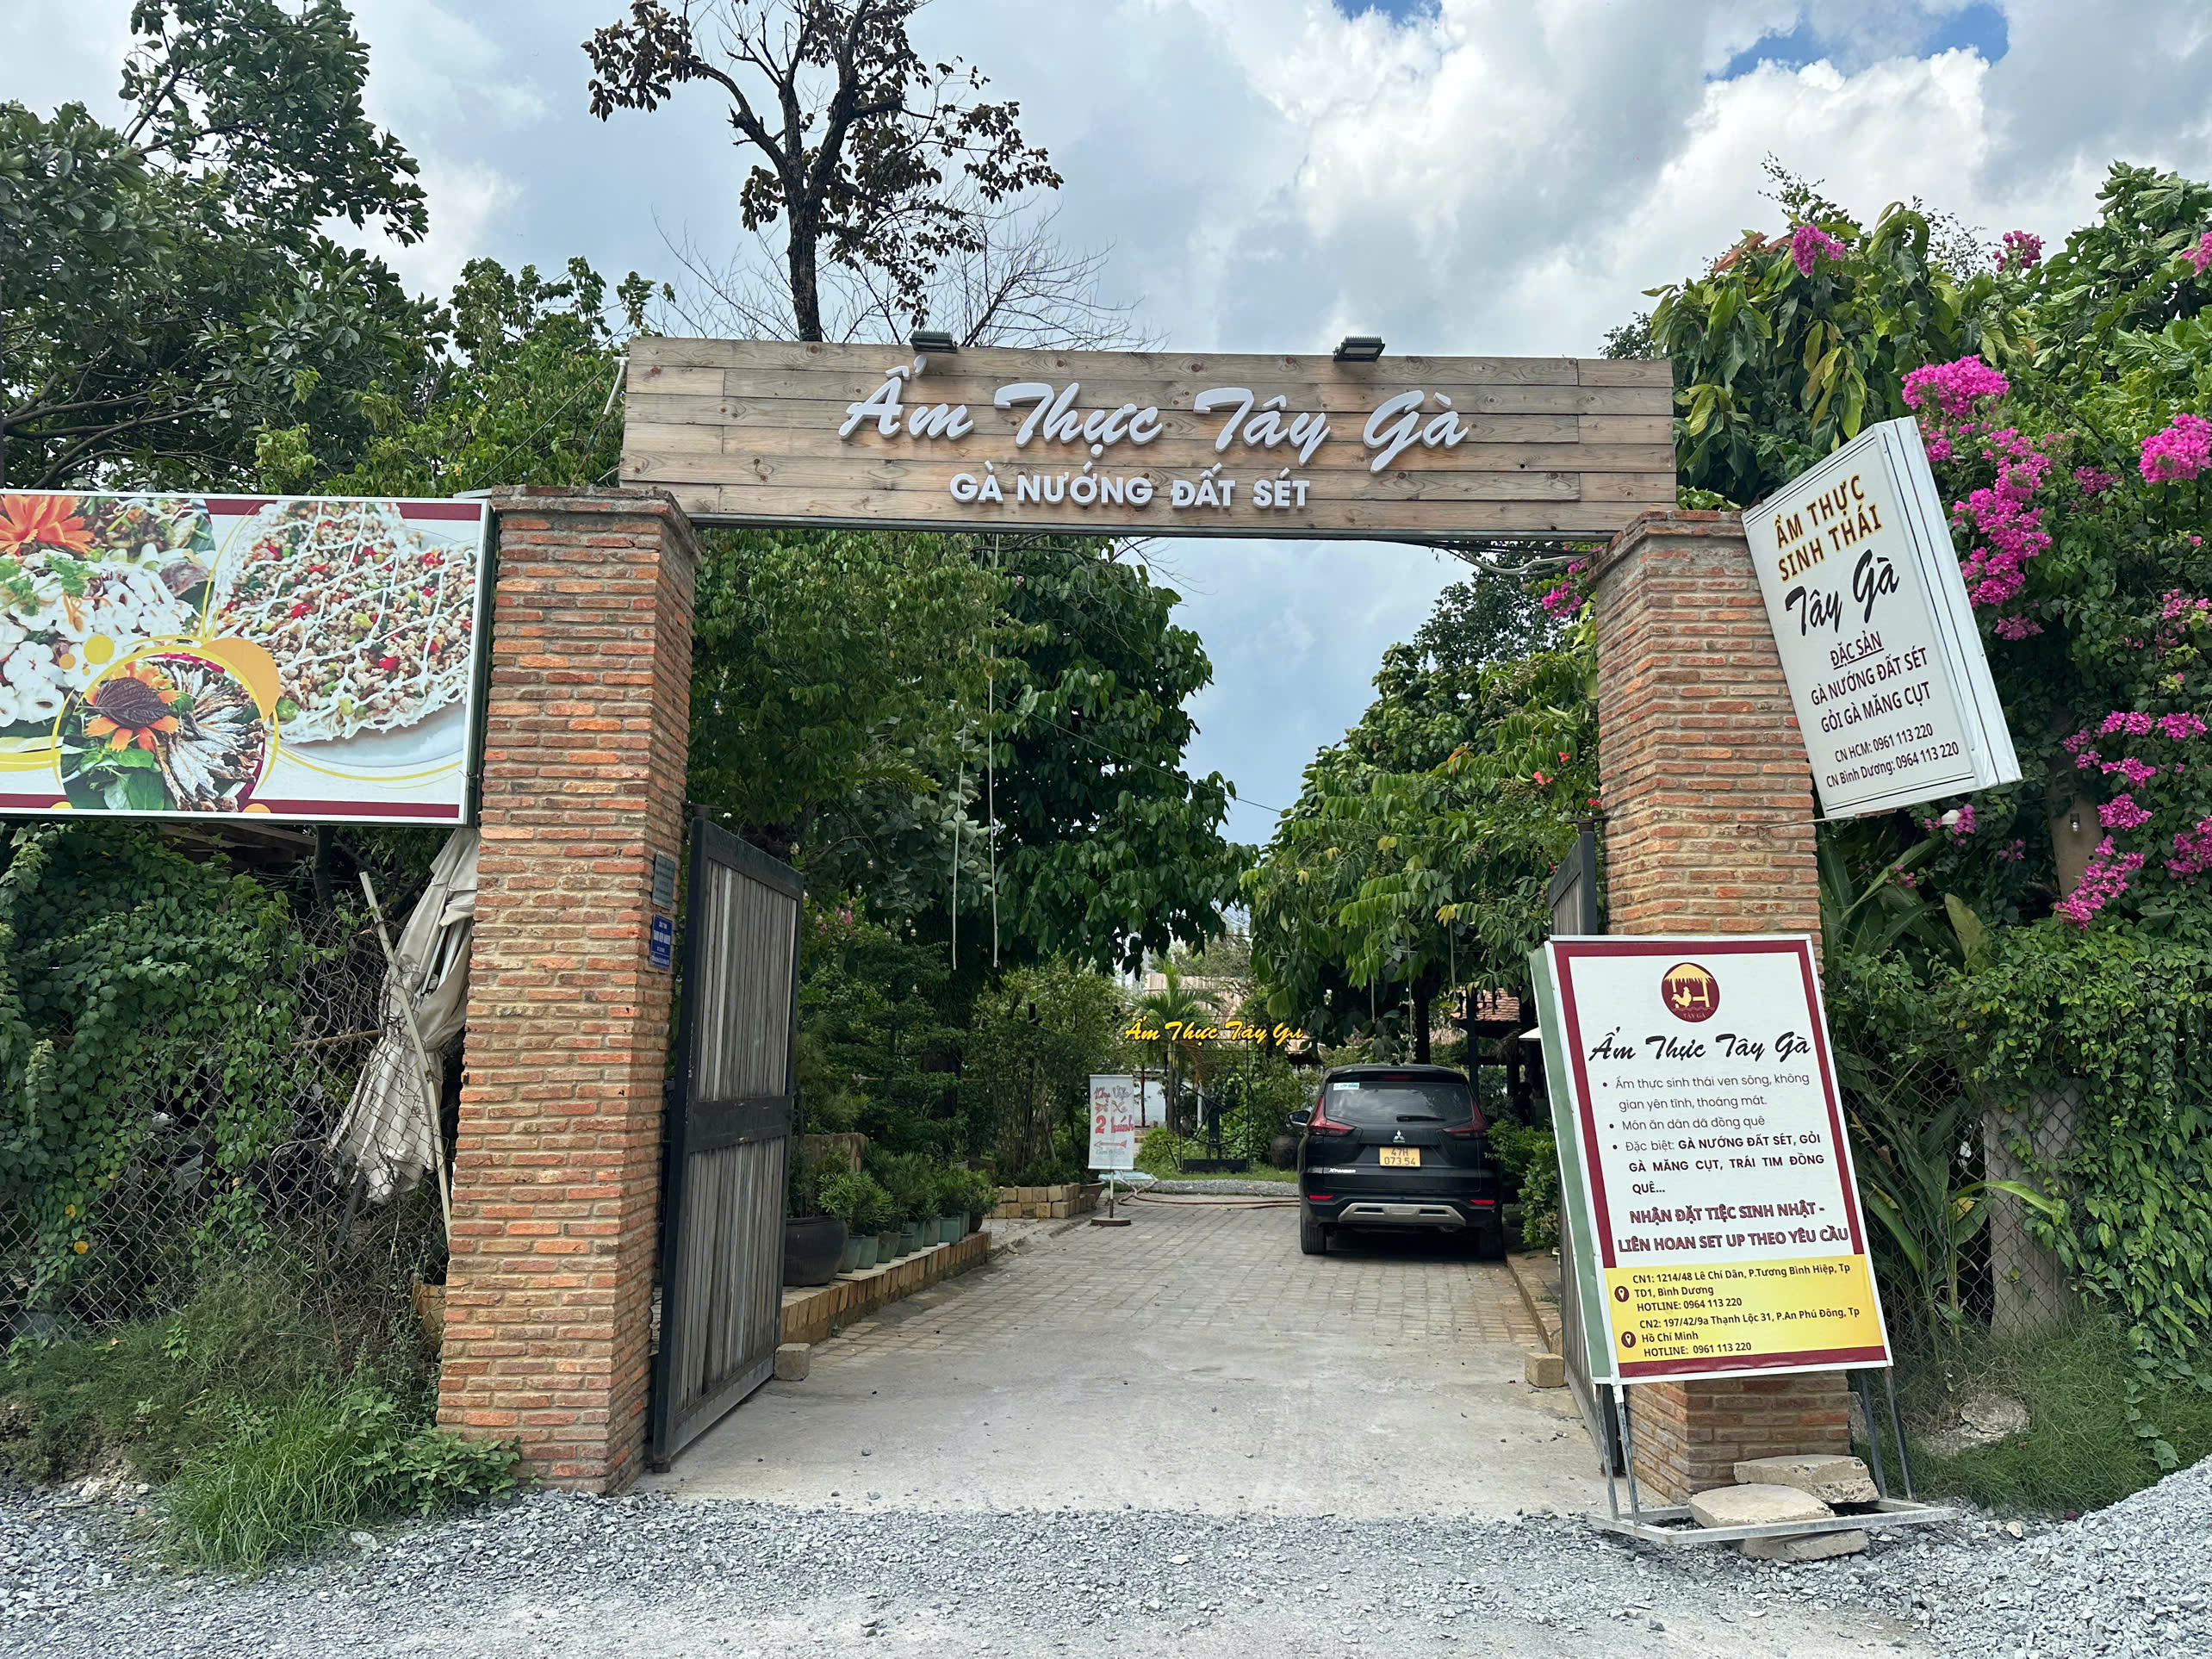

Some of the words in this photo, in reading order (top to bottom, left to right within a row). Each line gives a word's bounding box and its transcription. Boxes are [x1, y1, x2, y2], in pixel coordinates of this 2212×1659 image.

[838, 355, 973, 440] Ẩm
[994, 381, 1164, 458] Thực
[1194, 387, 1332, 466] Tây
[1363, 389, 1469, 474] Gà
[949, 461, 1003, 504] GÀ
[1016, 462, 1153, 506] NƯỚNG
[1171, 463, 1236, 508] ĐẤT
[1252, 467, 1310, 509] SÉT
[1775, 514, 1804, 549] ẨM
[1806, 475, 1865, 526] THỰC
[1778, 537, 1824, 581] SINH
[1828, 504, 1882, 551] THÁI
[1785, 586, 1842, 637] Tây
[1853, 549, 1899, 624] Gà
[1830, 642, 1855, 668] ĐẶC
[1855, 631, 1882, 656] SẢN
[1811, 683, 1828, 705] GÀ
[1828, 668, 1875, 699] NƯỚNG
[1876, 654, 1902, 681] ĐẤT
[1904, 645, 1928, 671] SÉT
[1821, 709, 1843, 733] GỎI
[1844, 702, 1862, 725] GÀ
[1862, 692, 1903, 719] MĂNG
[1904, 681, 1930, 707] CỤT
[1835, 749, 1849, 763] CN
[1849, 742, 1873, 759] HCM:
[1873, 734, 1895, 752] 0961
[1896, 729, 1914, 745] 113
[1915, 723, 1934, 740] 220
[1826, 773, 1839, 787] CN
[1841, 767, 1860, 784] Bình
[1860, 760, 1895, 779] Dương:
[1895, 752, 1919, 769] 0964
[1920, 747, 1939, 762] 113
[1940, 741, 1960, 758] 220
[1125, 1016, 1160, 1041] Ẩm
[1165, 1021, 1218, 1047] Thực
[1224, 1021, 1268, 1045] Tây
[1588, 1026, 1636, 1061] Ẩm
[1645, 1035, 1706, 1061] Thực
[1715, 1034, 1766, 1062] Tây
[1774, 1031, 1811, 1062] Gà
[1637, 1078, 1663, 1090] thực
[1692, 1076, 1715, 1087] thái
[1717, 1078, 1738, 1087] ven
[1741, 1075, 1772, 1087] sông,
[1774, 1073, 1810, 1086] không
[1619, 1099, 1644, 1113] gian
[1646, 1098, 1668, 1111] yên
[1670, 1097, 1695, 1109] tĩnh,
[1697, 1096, 1738, 1109] thoáng
[1096, 1115, 1106, 1134] 2
[1622, 1119, 1647, 1130] Món
[1650, 1119, 1665, 1129] ăn
[1668, 1117, 1690, 1129] dân
[1693, 1117, 1708, 1128] dã
[1711, 1115, 1741, 1130] đồng
[1743, 1116, 1765, 1129] quê
[1391, 1147, 1409, 1156] 47H
[1625, 1140, 1648, 1153] Đặc
[1651, 1140, 1675, 1152] biệt:
[1678, 1137, 1696, 1150] GÀ
[1699, 1135, 1744, 1149] NƯỚNG
[1747, 1135, 1769, 1147] ĐẤT
[1773, 1134, 1797, 1146] SÉT,
[1799, 1131, 1821, 1144] GỎI
[1384, 1157, 1416, 1165] 073.54
[1629, 1159, 1646, 1172] GÀ
[1653, 1159, 1689, 1171] MĂNG
[1695, 1159, 1723, 1172] CỤT,
[1729, 1155, 1756, 1168] TRÁI
[1762, 1156, 1783, 1167] TIM
[1789, 1152, 1824, 1165] ĐỒNG
[1632, 1180, 1666, 1195] QUÊ...
[1629, 1207, 1672, 1226] NHẬN
[1675, 1205, 1702, 1224] ĐẶT
[1705, 1203, 1737, 1222] TIỆC
[1739, 1204, 1774, 1219] SINH
[1778, 1199, 1816, 1218] NHẬT
[1618, 1235, 1650, 1252] LIÊN
[1653, 1236, 1696, 1251] HOAN
[1699, 1234, 1723, 1249] SET
[1726, 1233, 1745, 1247] UP
[1748, 1231, 1786, 1246] THEO
[1788, 1227, 1817, 1243] YÊU
[1819, 1224, 1849, 1241] CẦU
[1632, 1274, 1655, 1284] CN1:
[1656, 1271, 1693, 1283] 1214/48
[1694, 1271, 1706, 1281] Lê
[1708, 1269, 1723, 1280] Chí
[1724, 1268, 1747, 1280] Dân,
[1749, 1267, 1787, 1279] P.Tương
[1789, 1264, 1811, 1275] Bình
[1812, 1264, 1836, 1276] Hiệp,
[1838, 1264, 1850, 1274] Tp
[1634, 1289, 1656, 1298] TD1,
[1657, 1286, 1679, 1296] Bình
[1681, 1285, 1714, 1296] Dương
[1637, 1302, 1681, 1312] HOTLINE:
[1683, 1300, 1706, 1309] 0964
[1707, 1298, 1724, 1308] 113
[1725, 1297, 1743, 1307] 220
[1639, 1319, 1662, 1329] CN2:
[1663, 1316, 1709, 1327] 197/42/9a
[1711, 1314, 1741, 1327] Thạnh
[1743, 1313, 1759, 1324] Lộc
[1761, 1313, 1774, 1322] 31,
[1776, 1310, 1797, 1320] P.An
[1799, 1308, 1817, 1319] Phú
[1819, 1307, 1847, 1319] Đông,
[1848, 1308, 1860, 1318] Tp
[1641, 1333, 1656, 1343] Hồ
[1657, 1332, 1673, 1342] Chí
[1675, 1331, 1699, 1341] Minh
[1643, 1346, 1688, 1358] HOTLINE:
[1693, 1345, 1715, 1354] 0961
[1717, 1343, 1733, 1352] 113
[1736, 1342, 1752, 1351] 220
